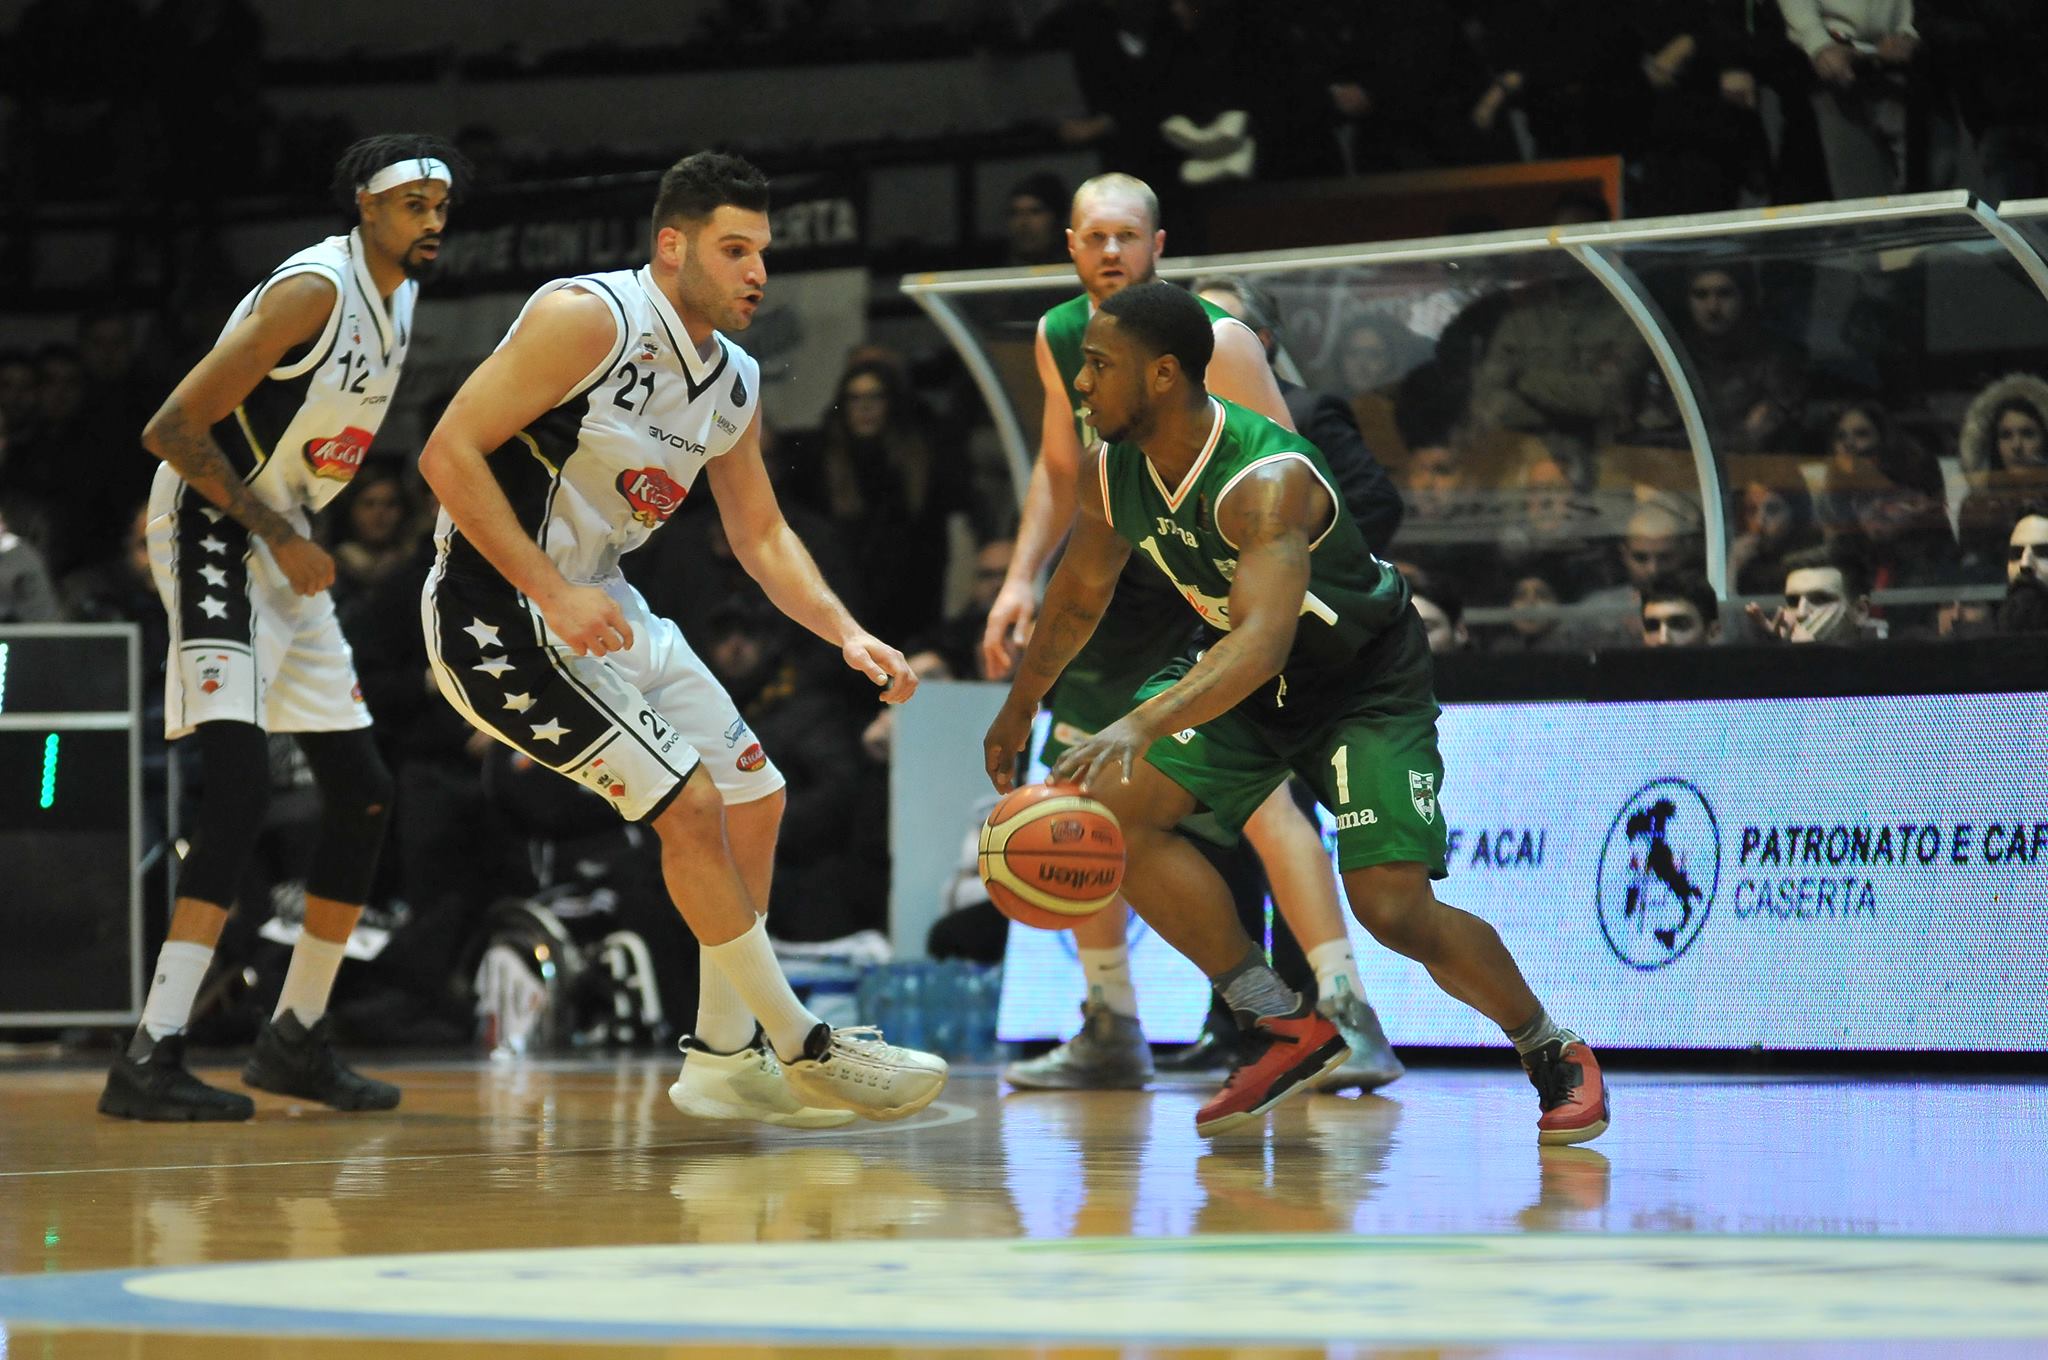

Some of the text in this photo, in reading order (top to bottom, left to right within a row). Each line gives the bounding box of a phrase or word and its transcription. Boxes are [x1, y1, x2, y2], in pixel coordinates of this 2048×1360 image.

[338, 350, 369, 393] 12
[613, 361, 656, 416] 21
[1331, 745, 1350, 804] 1
[1336, 808, 1378, 830] oma
[1471, 828, 1547, 868] ACAI
[1740, 825, 1941, 865] PATRONATO
[1950, 823, 1974, 865] E
[1039, 862, 1116, 889] molten
[1735, 876, 1876, 918] CASERTA
